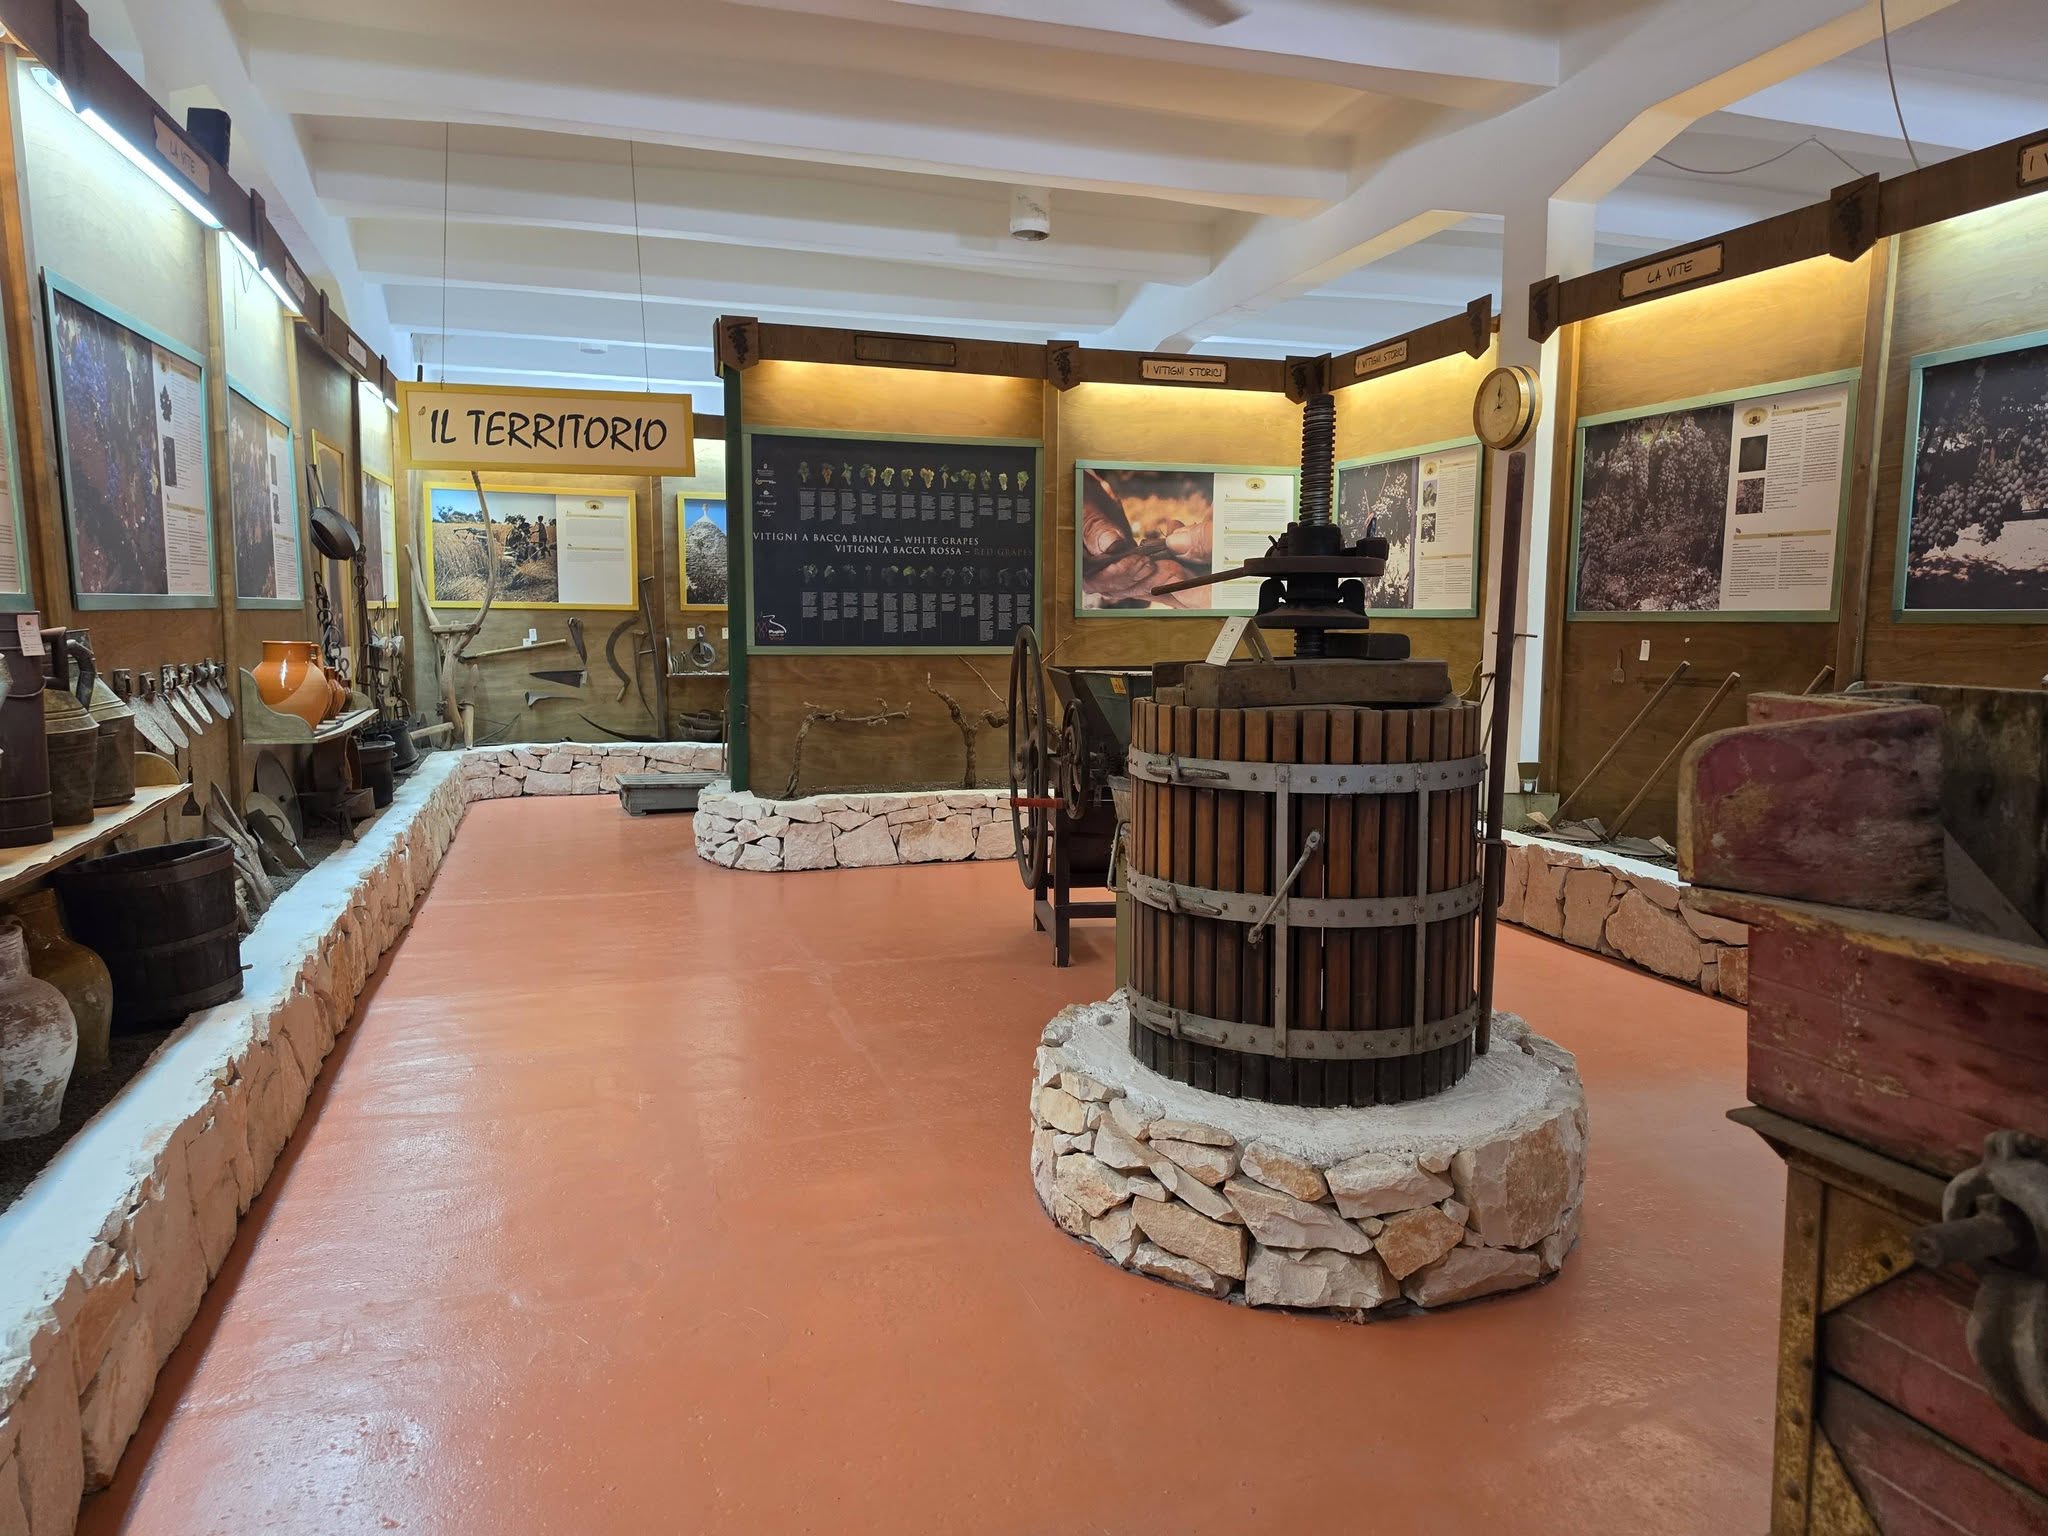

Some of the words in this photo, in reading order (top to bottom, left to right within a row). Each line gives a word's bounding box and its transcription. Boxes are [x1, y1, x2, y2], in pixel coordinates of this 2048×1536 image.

[1647, 269, 1662, 284] LA
[1666, 259, 1694, 278] VITE
[1153, 365, 1185, 376] VITIGNI
[1188, 367, 1222, 377] STORICI
[430, 409, 457, 444] IL
[466, 409, 668, 453] TERRITORIO
[752, 532, 798, 541] VITIGNI
[801, 533, 810, 542] A
[813, 533, 848, 543] BACCA
[852, 535, 892, 544] BIANCA
[904, 536, 938, 545] WHITE
[941, 536, 979, 546] GRAPES
[835, 545, 878, 554] VITIGNI
[882, 546, 889, 554] A
[893, 546, 926, 555] BACCA
[930, 547, 962, 556] ROSSA
